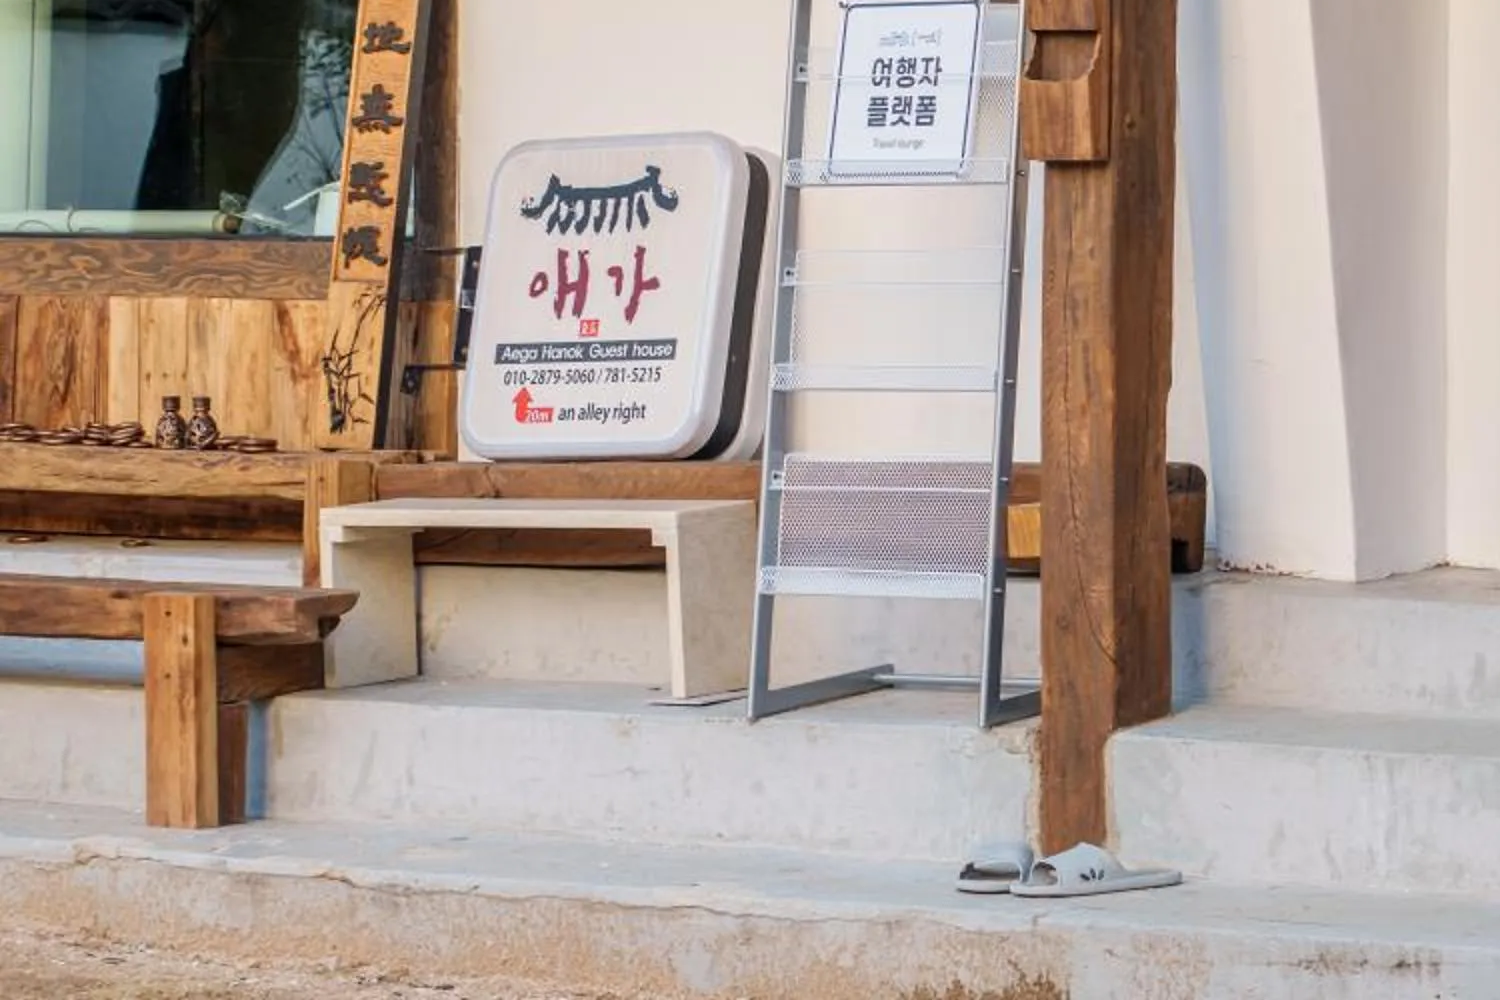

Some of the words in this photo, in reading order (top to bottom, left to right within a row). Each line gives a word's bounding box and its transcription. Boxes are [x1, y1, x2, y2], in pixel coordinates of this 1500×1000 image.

[871, 55, 943, 88] 여행자
[867, 95, 937, 127] 플랫폼
[589, 343, 628, 358] Guest
[632, 342, 672, 357] house
[558, 407, 575, 421] an
[578, 402, 611, 424] alley
[613, 401, 647, 424] right
